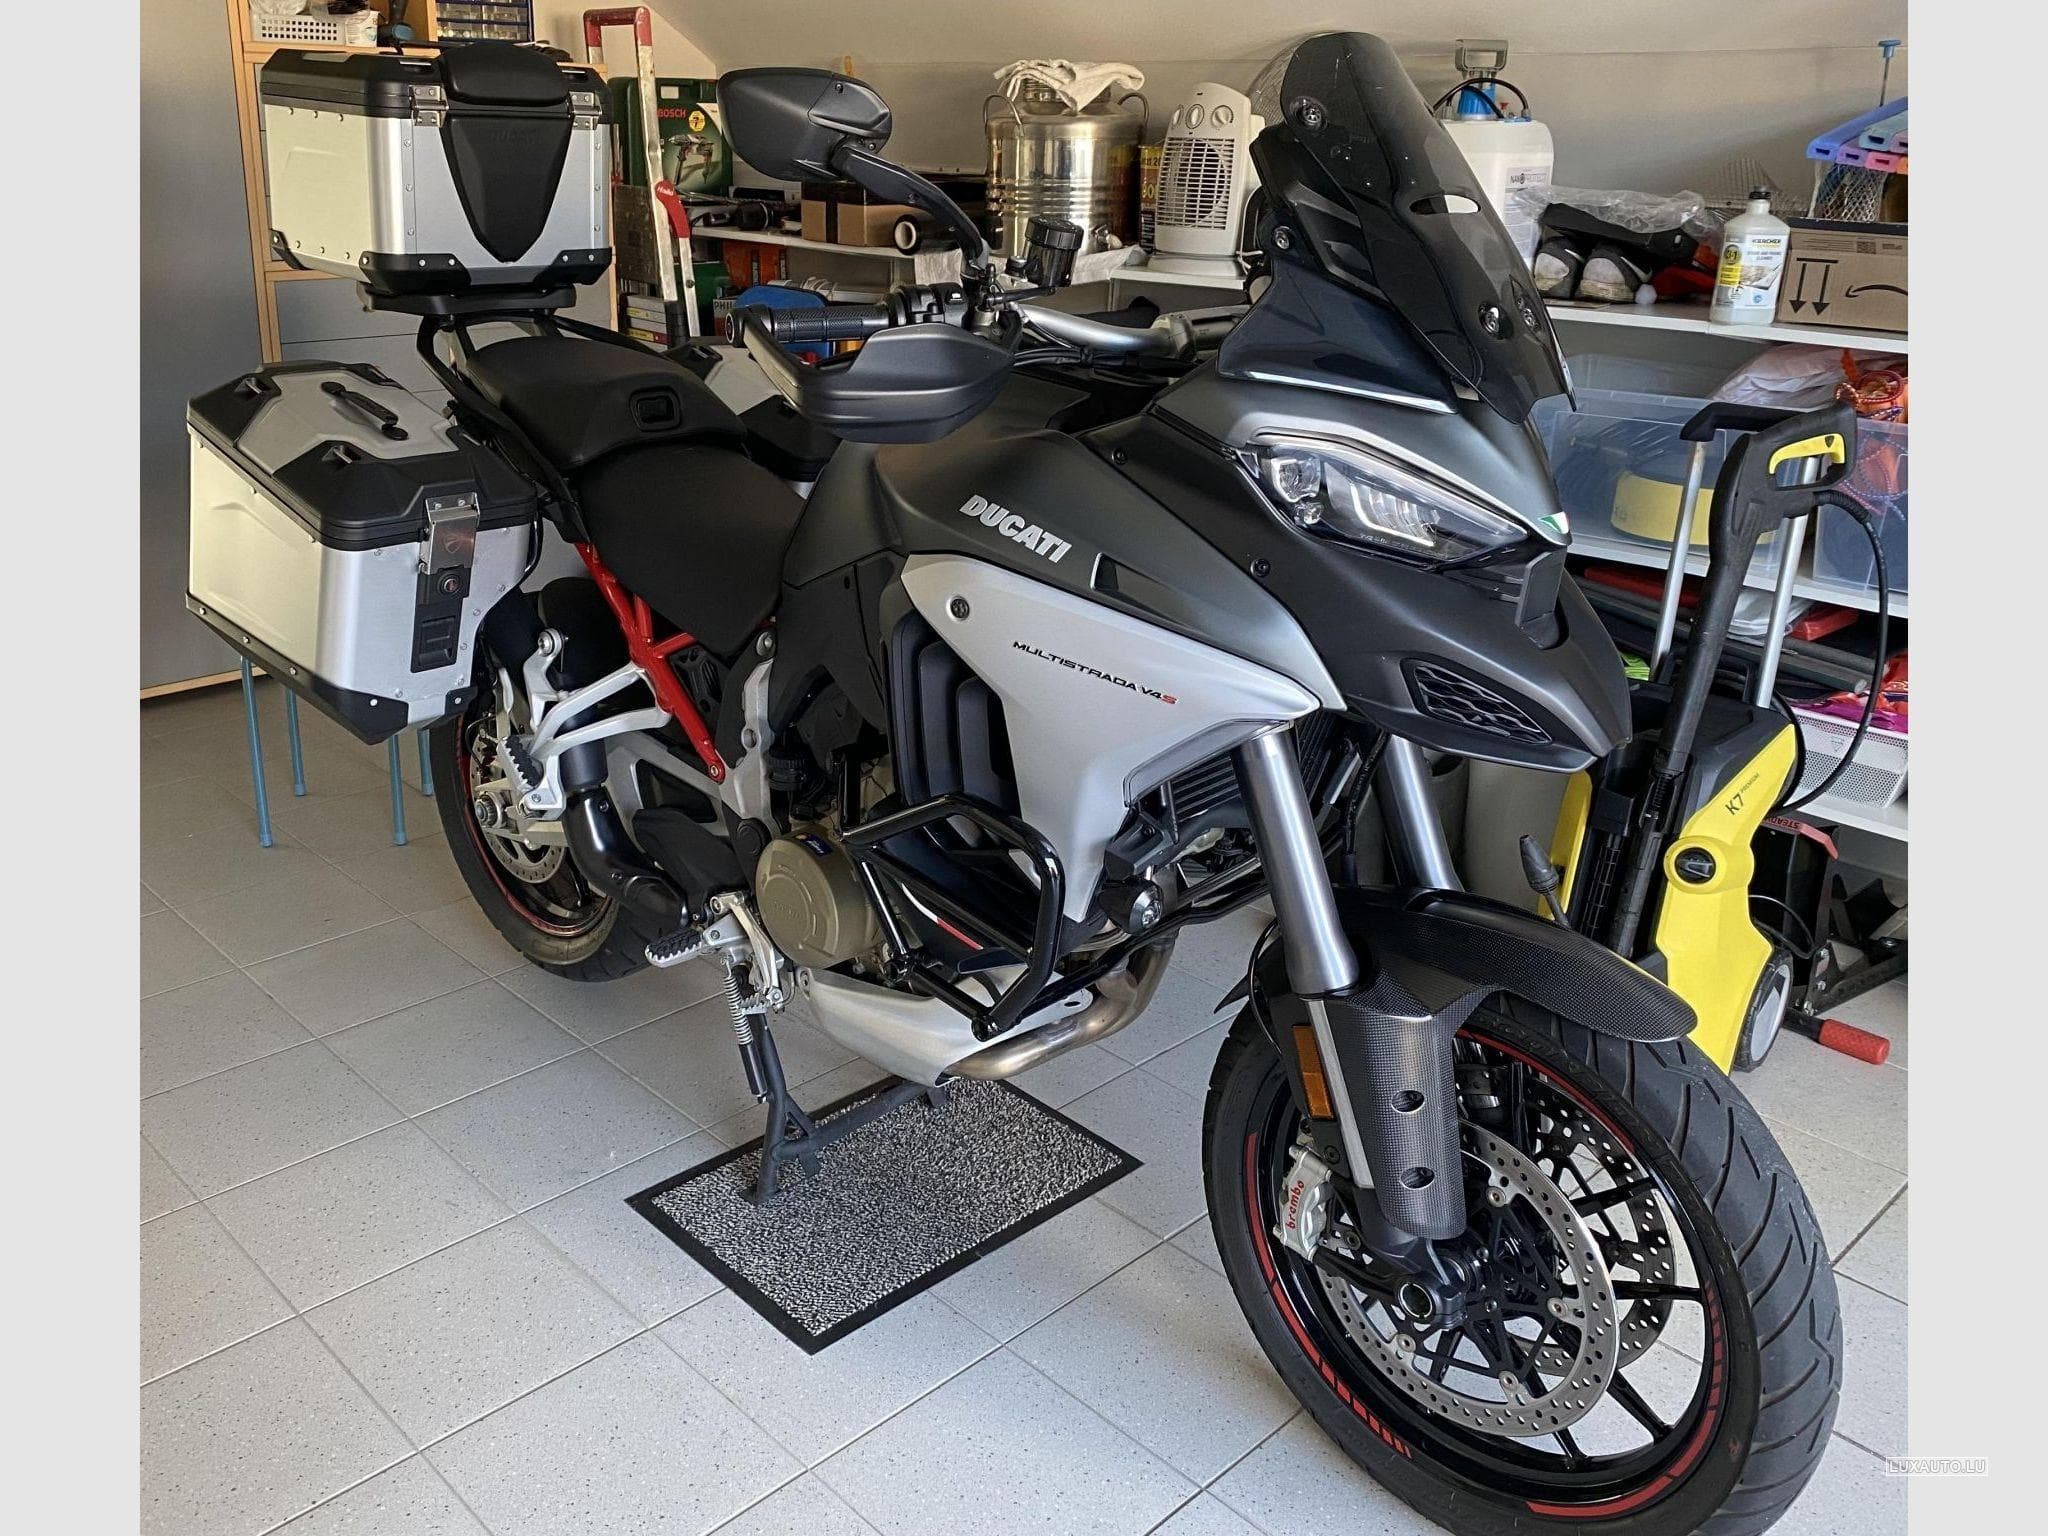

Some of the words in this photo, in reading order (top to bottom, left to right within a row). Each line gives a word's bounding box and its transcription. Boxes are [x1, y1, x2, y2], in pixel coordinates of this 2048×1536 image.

[959, 494, 1072, 564] DUCATI
[1013, 641, 1137, 691] MULTISTRADA
[1141, 686, 1177, 705] V4S
[1725, 792, 1743, 815] K7
[1285, 1180, 1305, 1229] brembo
